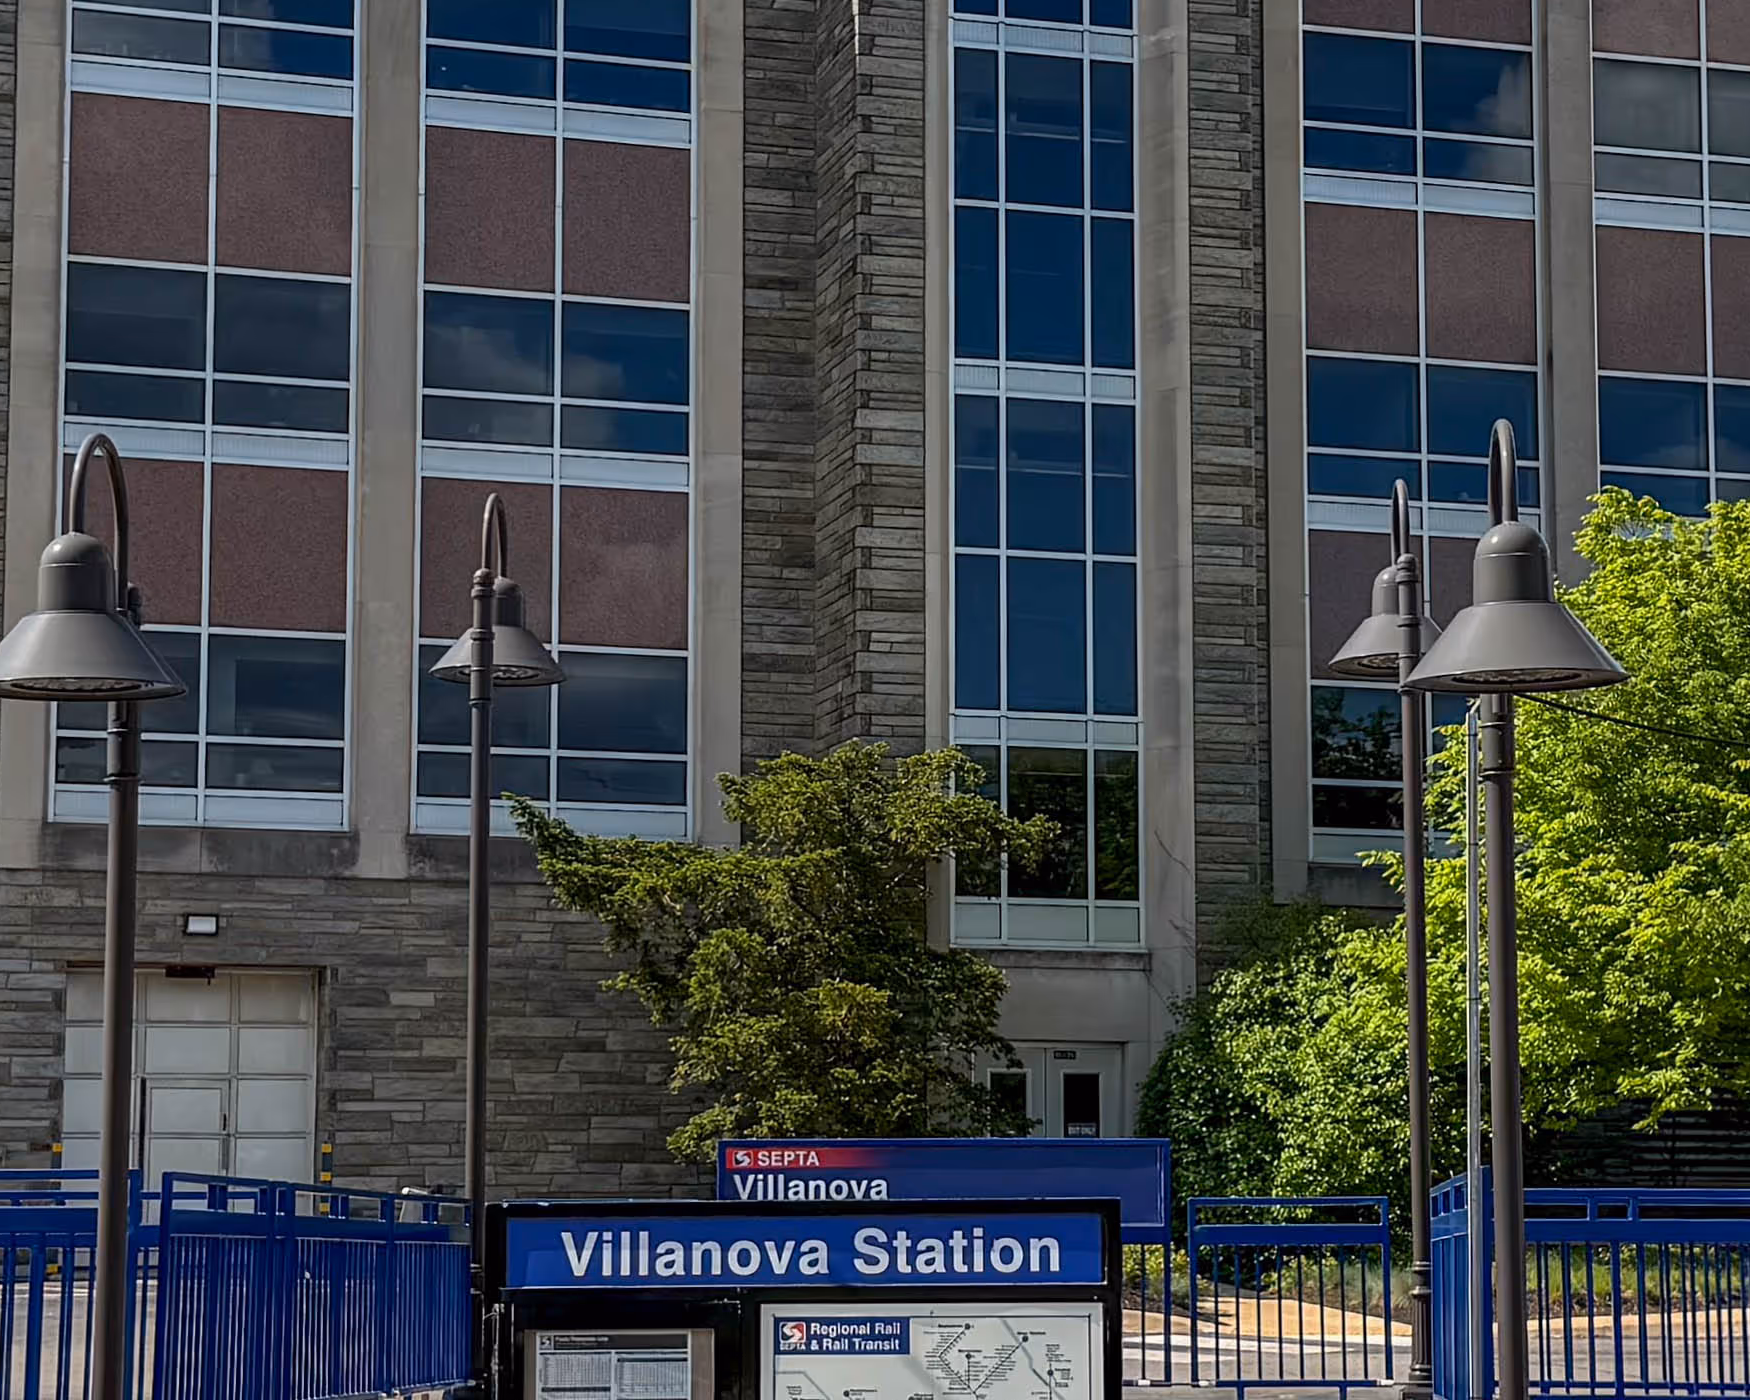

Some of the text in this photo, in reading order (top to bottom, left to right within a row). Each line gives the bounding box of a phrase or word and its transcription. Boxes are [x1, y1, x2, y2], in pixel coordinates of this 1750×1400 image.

[757, 1150, 820, 1167] SEPTA
[733, 1173, 889, 1199] Villanova
[561, 1226, 1061, 1278] Villanova Station
[810, 1322, 901, 1338] Regional Rail
[810, 1338, 901, 1351] & Rail Transit
